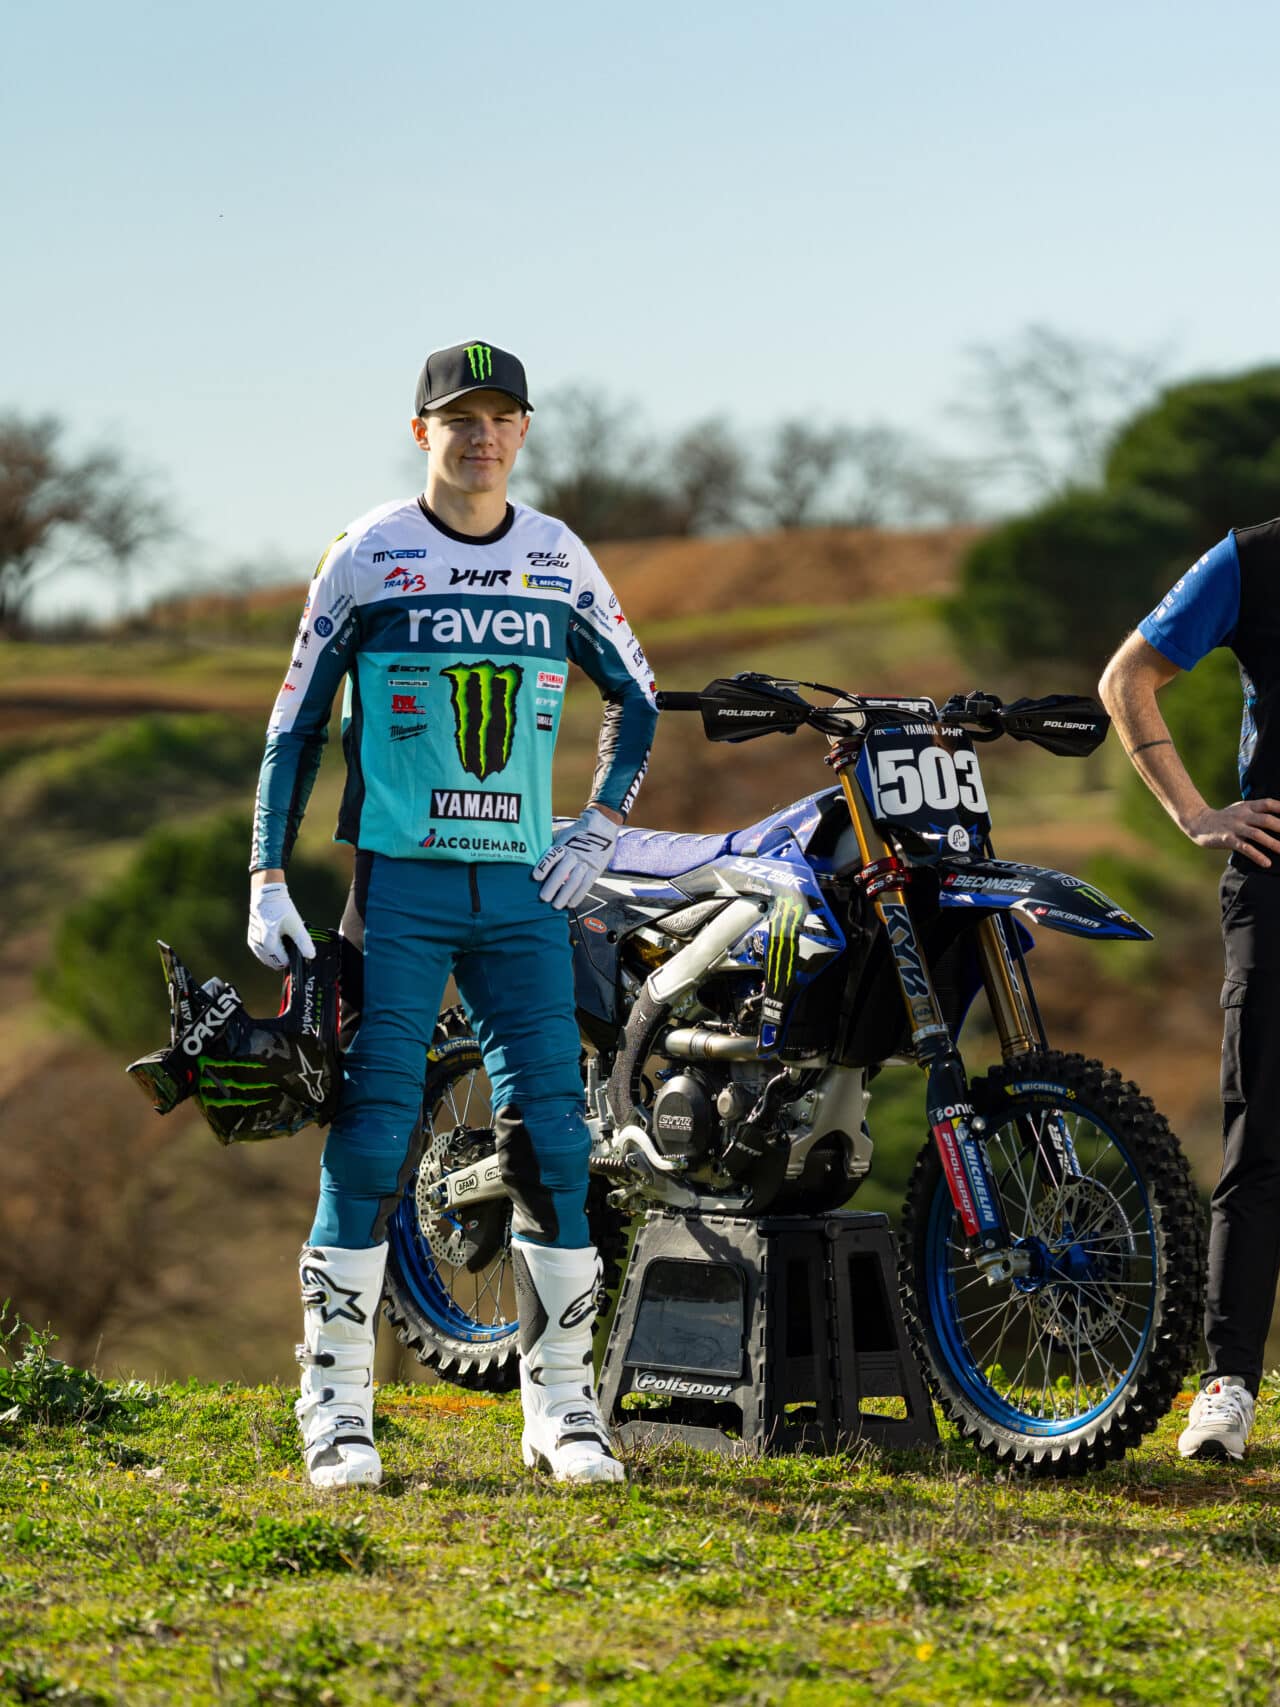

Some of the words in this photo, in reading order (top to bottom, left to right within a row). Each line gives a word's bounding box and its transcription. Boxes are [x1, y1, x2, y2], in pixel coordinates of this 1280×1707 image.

[526, 552, 567, 560] BLU
[530, 560, 570, 568] CRU
[448, 568, 512, 587] VHR
[408, 607, 551, 649] raven
[718, 709, 776, 717] POLISPORT
[903, 724, 939, 736] YAMAHA
[941, 727, 963, 737] VHR
[1043, 720, 1096, 731] POLISPORT
[877, 746, 989, 816] 503
[435, 792, 519, 821] YAMAHA
[537, 845, 563, 873] FIVE
[881, 903, 931, 999] KYB
[182, 987, 242, 1056] OAKLEY
[1022, 1081, 1064, 1094] MICHELIN
[457, 1178, 475, 1192] AFAM
[964, 1144, 995, 1223] MICHELIN
[639, 1373, 732, 1397] Polisport
